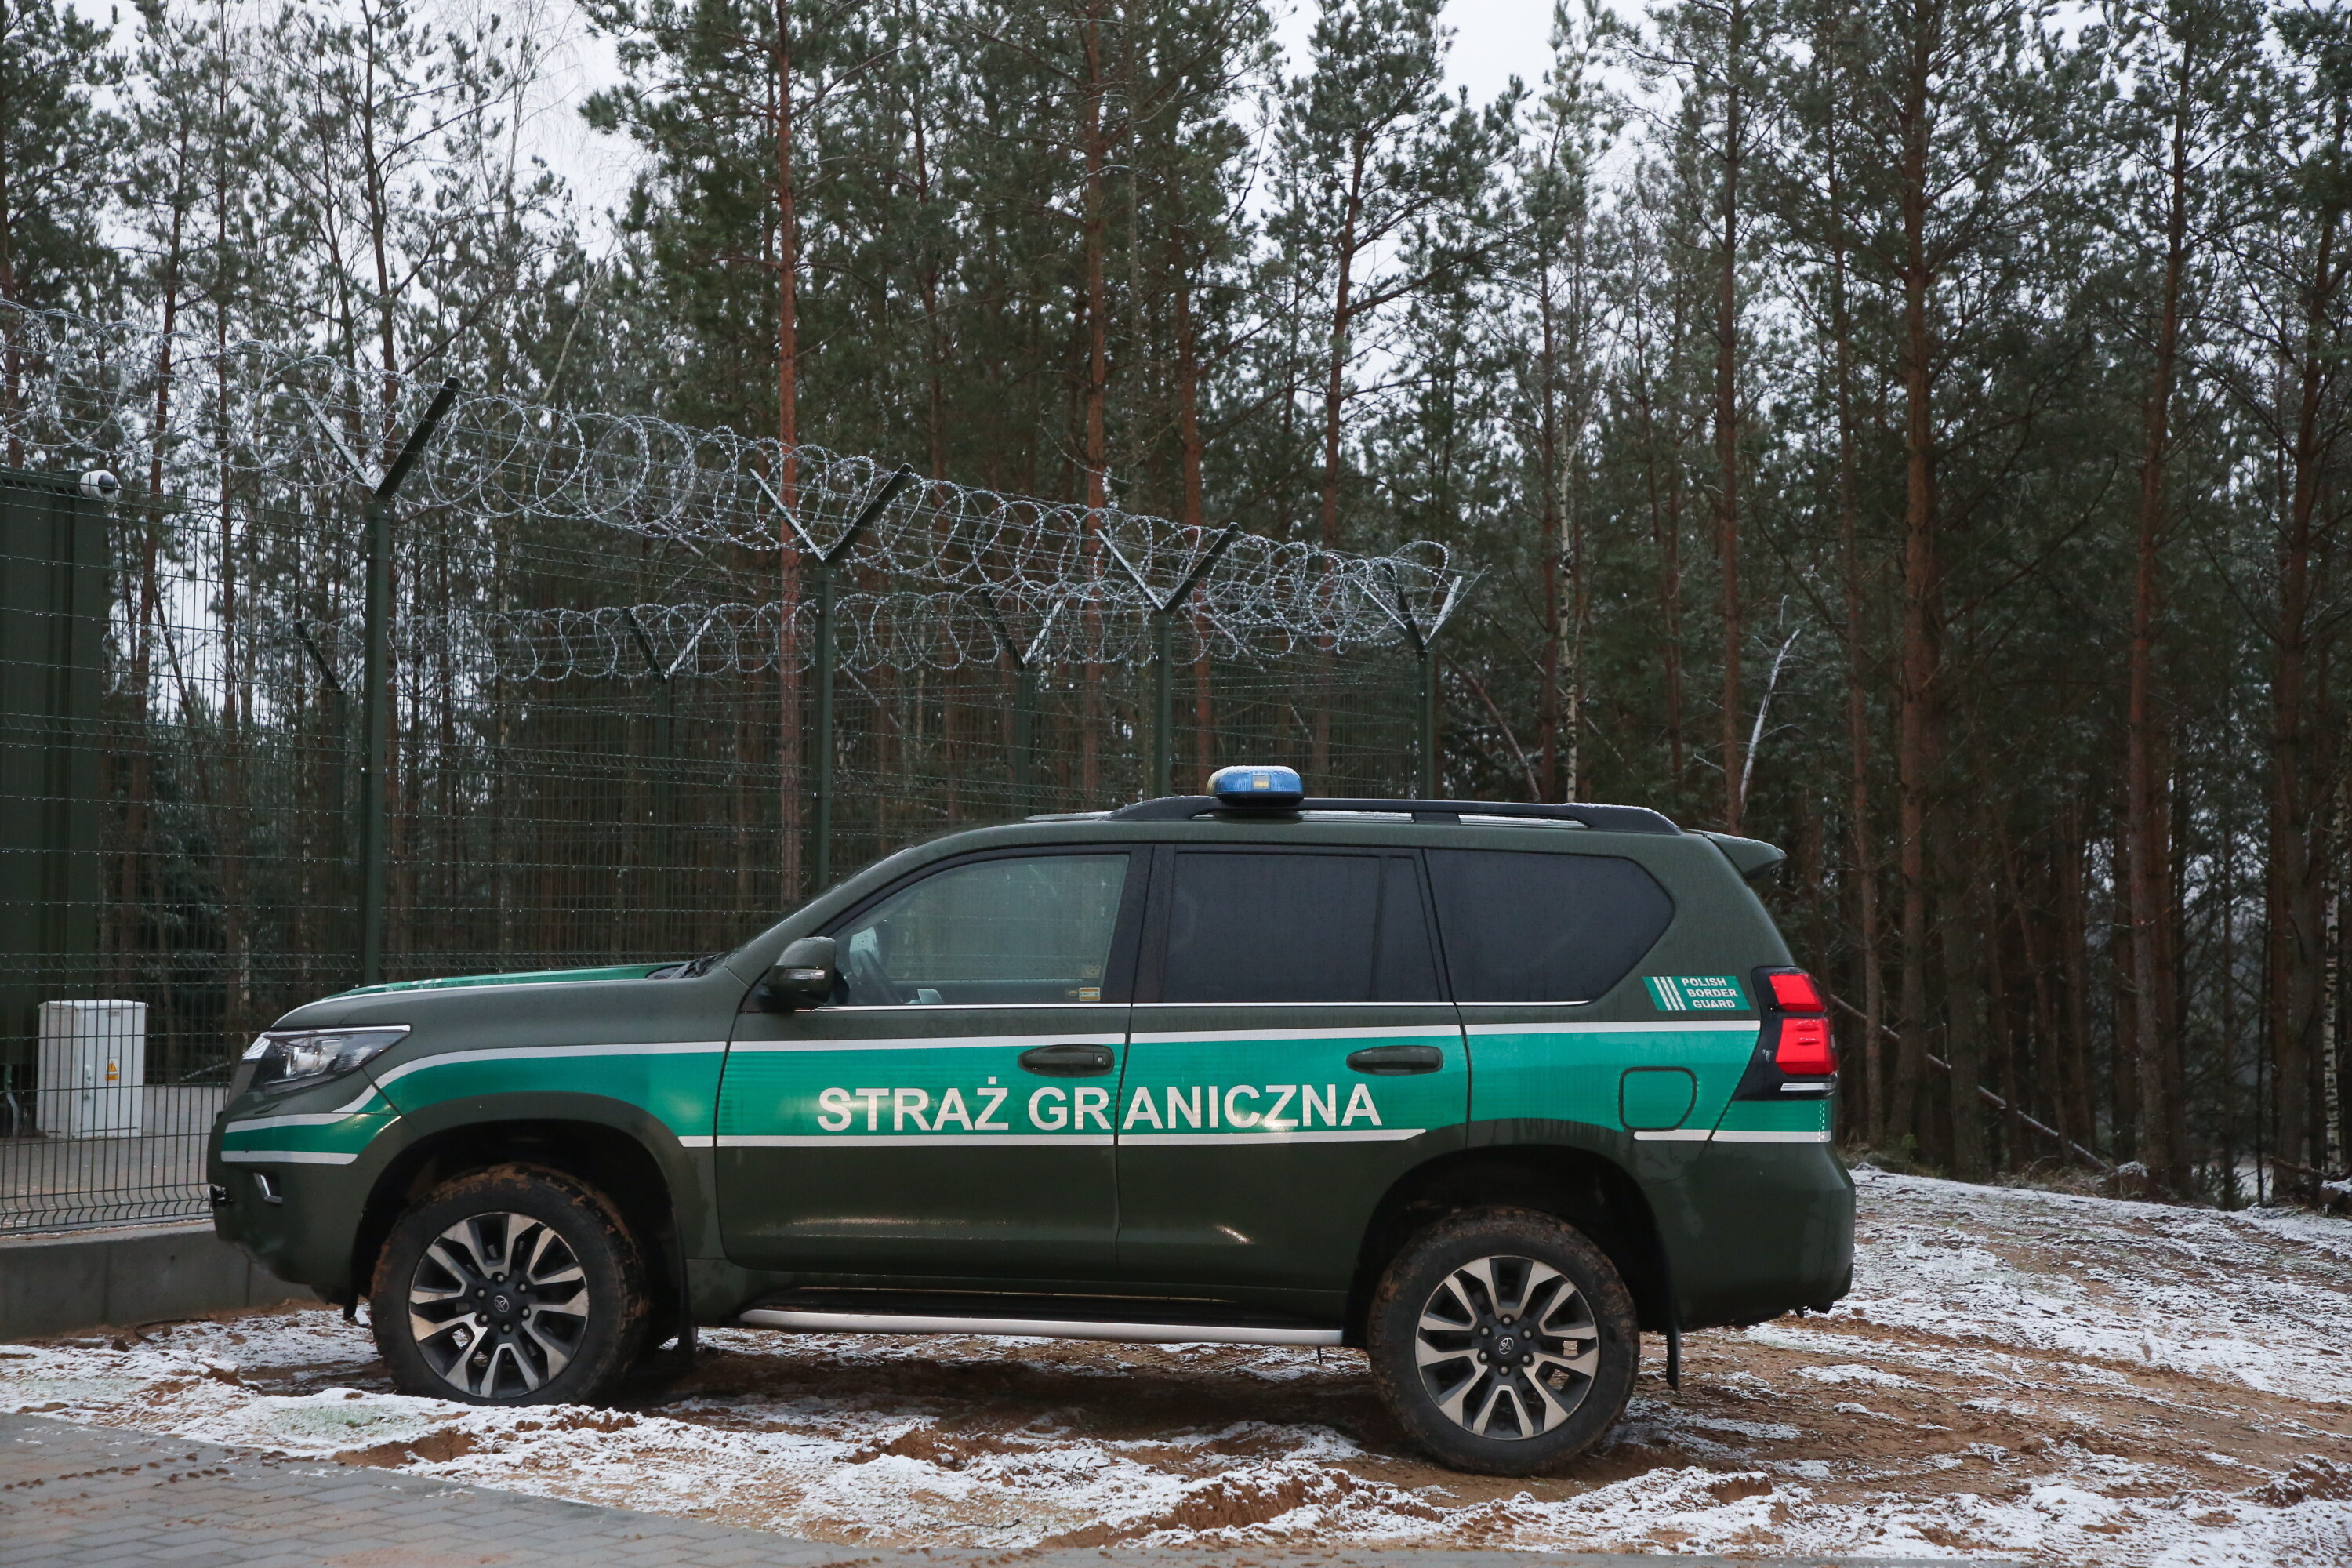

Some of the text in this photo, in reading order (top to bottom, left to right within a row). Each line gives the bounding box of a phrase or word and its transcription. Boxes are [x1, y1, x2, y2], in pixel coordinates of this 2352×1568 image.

[1681, 978, 1727, 986] POLISH
[1686, 989, 1738, 997] BORDER
[1692, 1000, 1736, 1008] GUARD
[817, 1076, 1382, 1131] STRAŻ GRANICZNA
